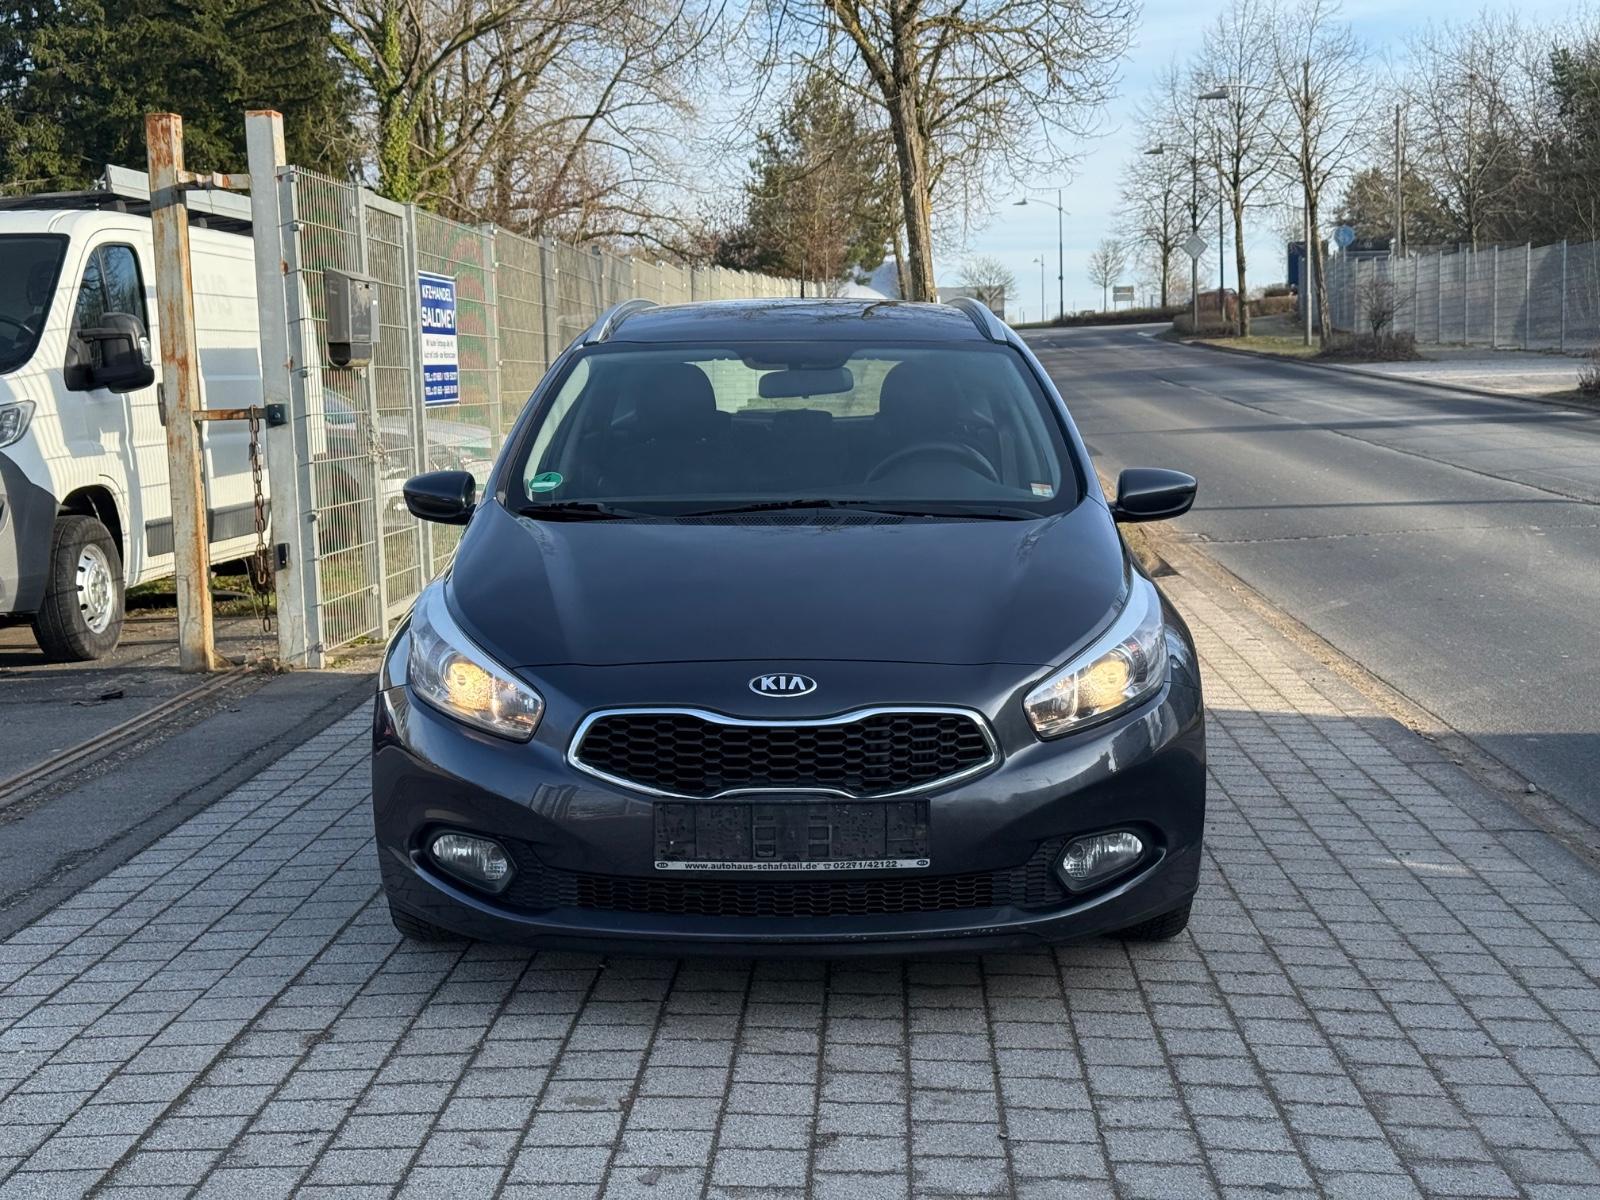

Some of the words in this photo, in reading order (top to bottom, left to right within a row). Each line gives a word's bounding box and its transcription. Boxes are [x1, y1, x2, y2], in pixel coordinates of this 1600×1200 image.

[422, 307, 455, 328] SALOMEY
[761, 676, 806, 690] KIA
[684, 861, 817, 871] www.autohaus-schafstall.de
[833, 860, 897, 870] 02271/42122
